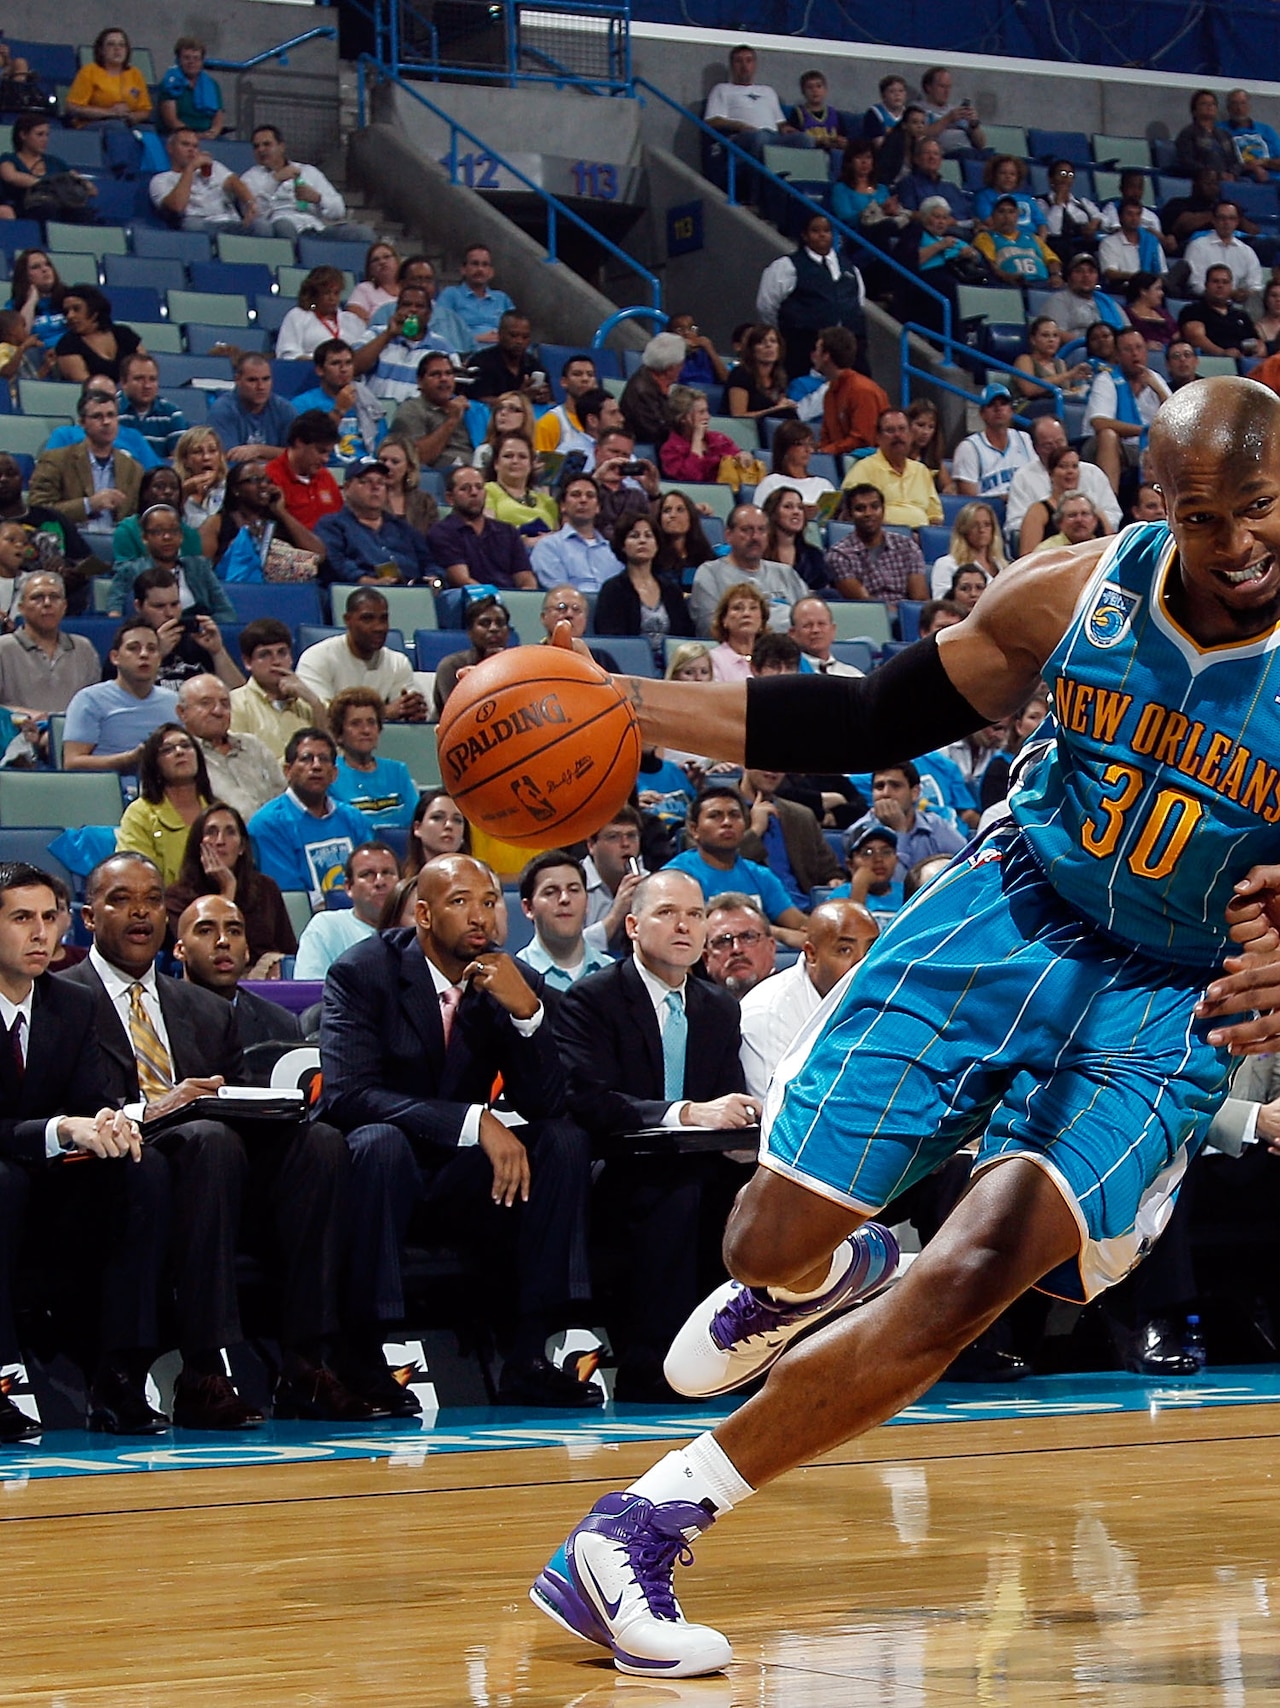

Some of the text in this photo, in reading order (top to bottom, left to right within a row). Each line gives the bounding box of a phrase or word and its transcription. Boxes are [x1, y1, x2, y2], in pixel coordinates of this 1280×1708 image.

[570, 160, 619, 200] 113
[446, 693, 567, 783] SPALDING
[1056, 677, 1133, 743] NEW
[1080, 761, 1204, 880] 30
